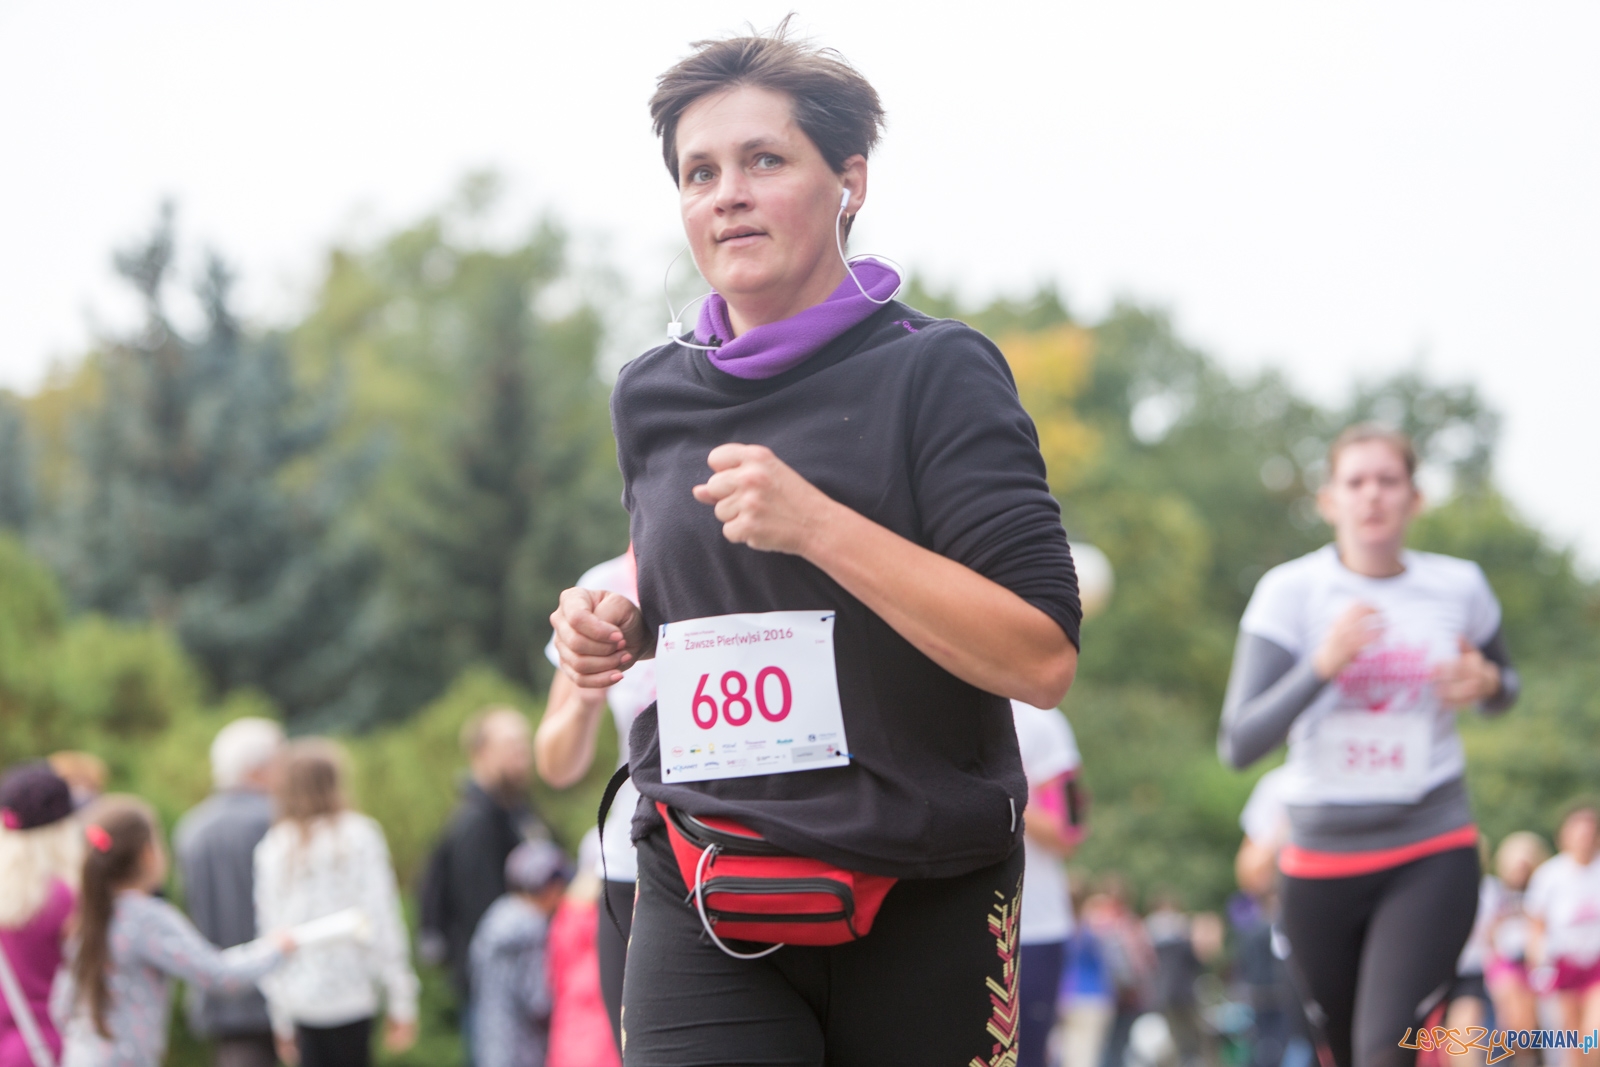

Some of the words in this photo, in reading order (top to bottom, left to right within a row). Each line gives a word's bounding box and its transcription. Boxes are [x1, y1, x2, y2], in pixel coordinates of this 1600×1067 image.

[684, 639, 715, 651] Zawsze
[716, 631, 760, 646] Pier(w)si
[763, 628, 793, 641] 2016
[692, 665, 792, 730] 680
